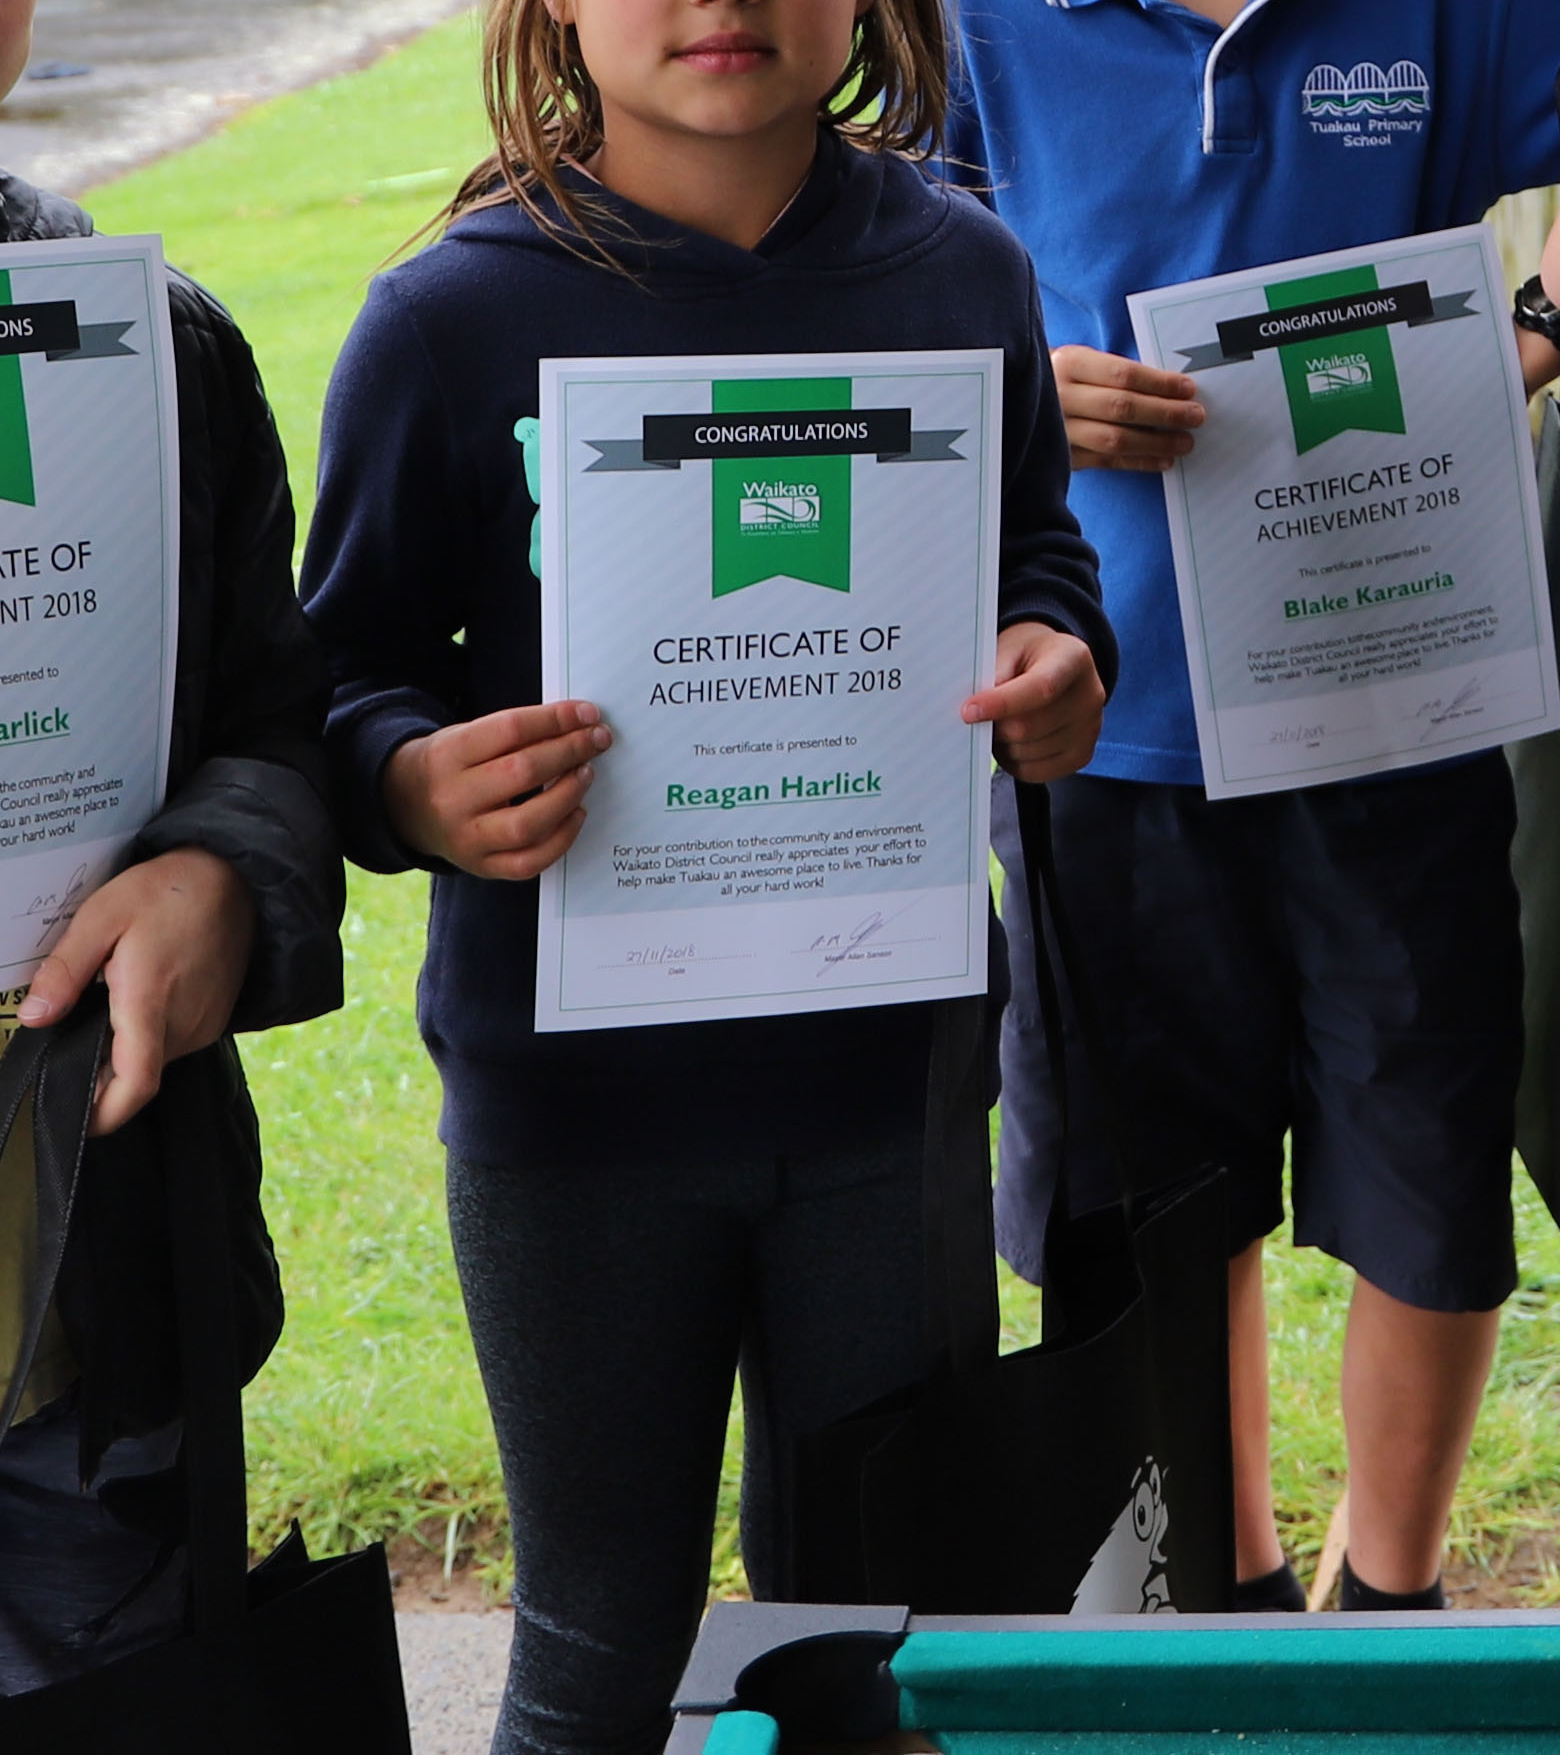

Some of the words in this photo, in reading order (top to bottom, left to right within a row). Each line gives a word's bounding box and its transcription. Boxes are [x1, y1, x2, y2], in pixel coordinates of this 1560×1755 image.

[1310, 121, 1360, 132] Tuakau
[1369, 118, 1422, 132] Primary
[1343, 133, 1391, 147] School
[1259, 297, 1397, 336] CONGRATULATIONS
[1305, 353, 1366, 372] Waikato
[694, 422, 867, 443] CONGRATULATIONS
[743, 481, 817, 497] Waikato
[1254, 462, 1412, 510] CERTIFICATE
[1419, 453, 1453, 478] OF
[1257, 496, 1407, 542] ACHIEVEMENT
[1415, 487, 1460, 512] 2018
[50, 540, 91, 572] OF
[1298, 567, 1318, 578] This
[1319, 559, 1363, 574] certificate
[1365, 556, 1373, 565] is
[1374, 545, 1419, 565] presented
[1420, 545, 1431, 553] to
[43, 588, 97, 618] 2018
[1284, 594, 1348, 618] Blake
[1356, 571, 1454, 605] Karauria
[653, 628, 848, 664] CERTIFICATE
[859, 625, 900, 652] OF
[46, 667, 59, 678] to
[649, 672, 839, 705] ACHIEVEMENT
[847, 668, 901, 693] 2018
[693, 743, 716, 756] This
[719, 740, 773, 754] certificate
[775, 742, 784, 750] is
[787, 734, 842, 753] presented
[844, 735, 857, 746] to
[17, 771, 75, 790] community
[77, 764, 95, 779] and
[666, 783, 769, 810] Reagan
[781, 769, 881, 798] Harlick
[0, 792, 40, 811] Council
[43, 788, 69, 803] really
[72, 778, 123, 799] appreciates
[18, 815, 31, 826] an
[34, 805, 81, 823] awesome
[83, 799, 107, 816] place
[109, 796, 119, 807] to
[22, 826, 45, 842] hard
[613, 844, 633, 856] For
[635, 844, 662, 858] your
[664, 839, 733, 853] contribution
[736, 837, 749, 848] to
[749, 835, 768, 847] the
[768, 831, 830, 845] community
[832, 827, 853, 840] and
[612, 859, 661, 872] Waikato
[664, 856, 705, 868] District
[709, 851, 752, 865] Council
[755, 849, 784, 862] really
[787, 845, 849, 861] appreciates
[855, 843, 880, 856] your
[882, 838, 911, 851] effort
[914, 838, 926, 848] to
[617, 875, 642, 889] help
[645, 872, 676, 885] make
[679, 870, 720, 882] Tuakau
[723, 870, 737, 880] an
[740, 866, 793, 878] awesome
[795, 862, 824, 877] place
[827, 861, 840, 871] to
[866, 854, 903, 867] Thanks
[906, 853, 922, 864] for
[720, 883, 732, 895] all
[735, 884, 761, 897] your
[764, 879, 790, 891] hard
